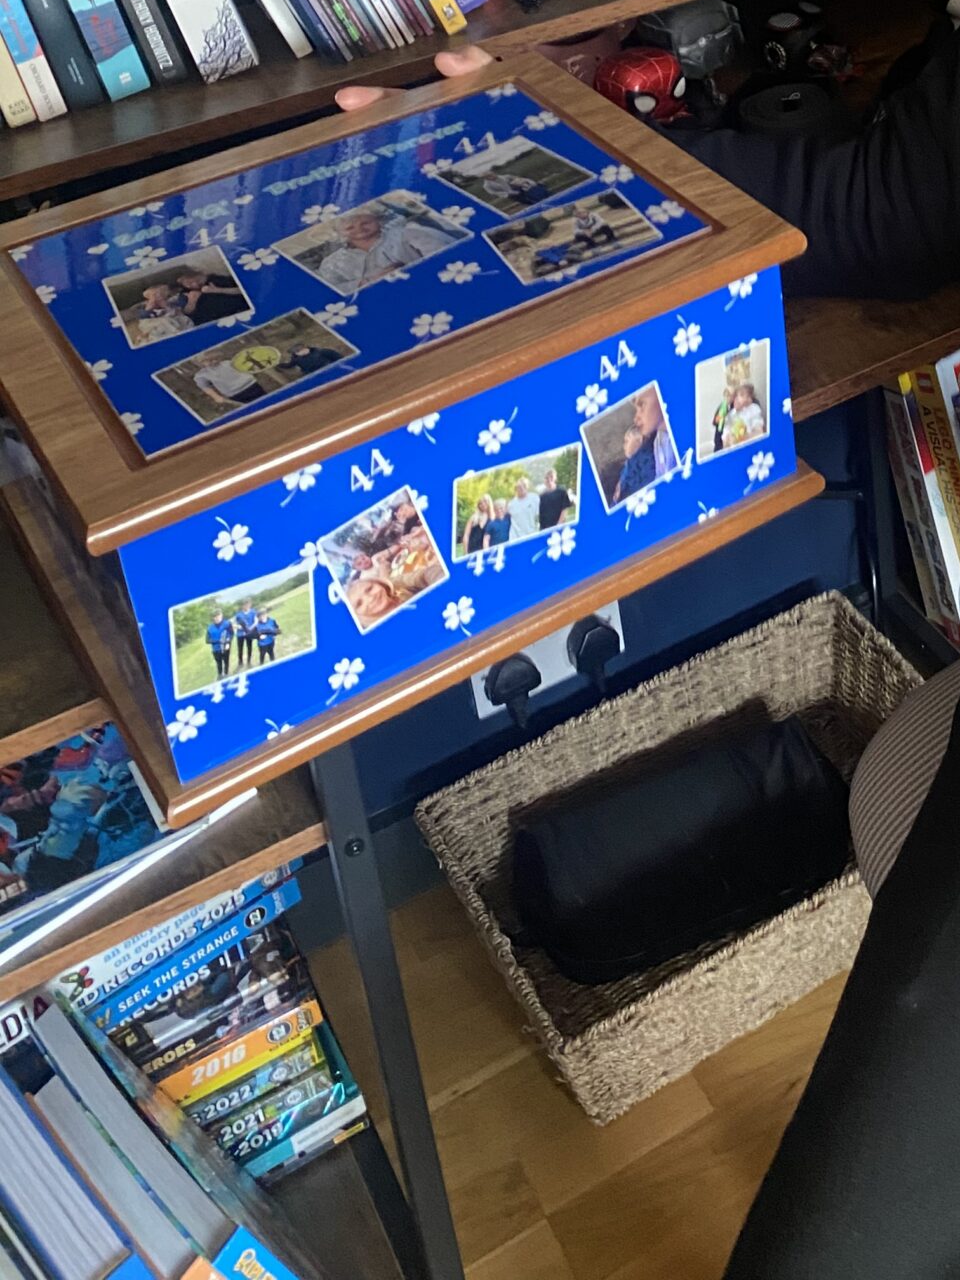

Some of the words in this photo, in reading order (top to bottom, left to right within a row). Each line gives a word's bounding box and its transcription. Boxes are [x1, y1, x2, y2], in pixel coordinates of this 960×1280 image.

[452, 131, 497, 156] 44
[189, 222, 239, 247] 44
[599, 340, 637, 381] 44
[921, 404, 931, 416] A
[932, 406, 951, 449] LEGO
[924, 417, 947, 475] VISUAL
[350, 448, 395, 493] 44
[103, 925, 198, 994] RECORDS
[202, 888, 247, 926] 2025
[114, 955, 131, 968] on
[134, 932, 171, 955] every
[118, 986, 151, 1013] SEEK
[153, 967, 179, 988] THE
[182, 926, 239, 968] STRANGE
[203, 1084, 250, 1120] 2022
[220, 1107, 265, 1143] 2021
[238, 1121, 284, 1155] 2019
